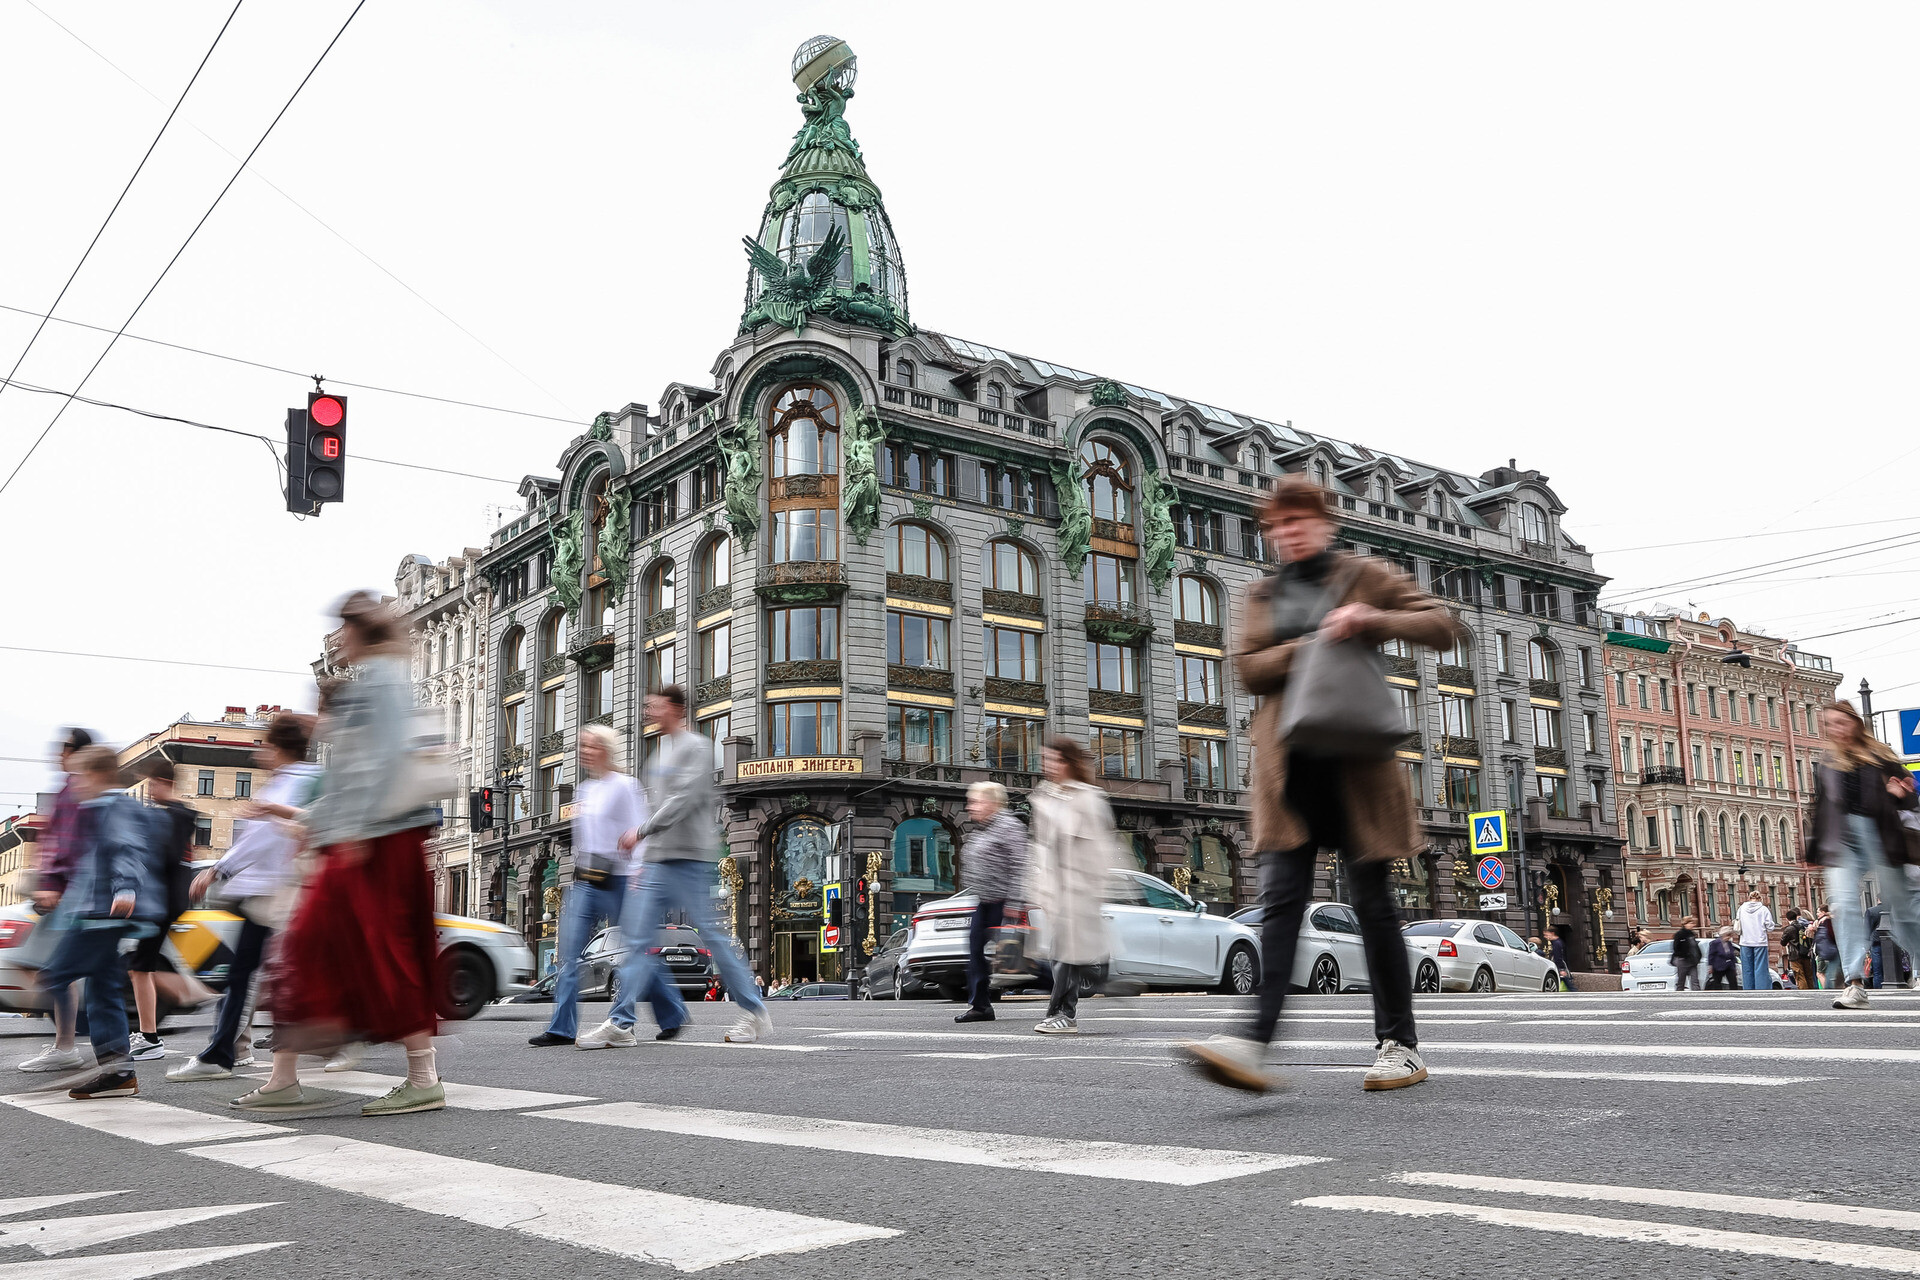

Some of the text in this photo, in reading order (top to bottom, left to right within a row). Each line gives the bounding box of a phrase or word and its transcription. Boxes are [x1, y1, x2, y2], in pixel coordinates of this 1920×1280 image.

[743, 759, 855, 776] КОМПАНІЯ ЗИНГЕРЪ
[484, 803, 491, 812] 6
[859, 894, 865, 903] 6
